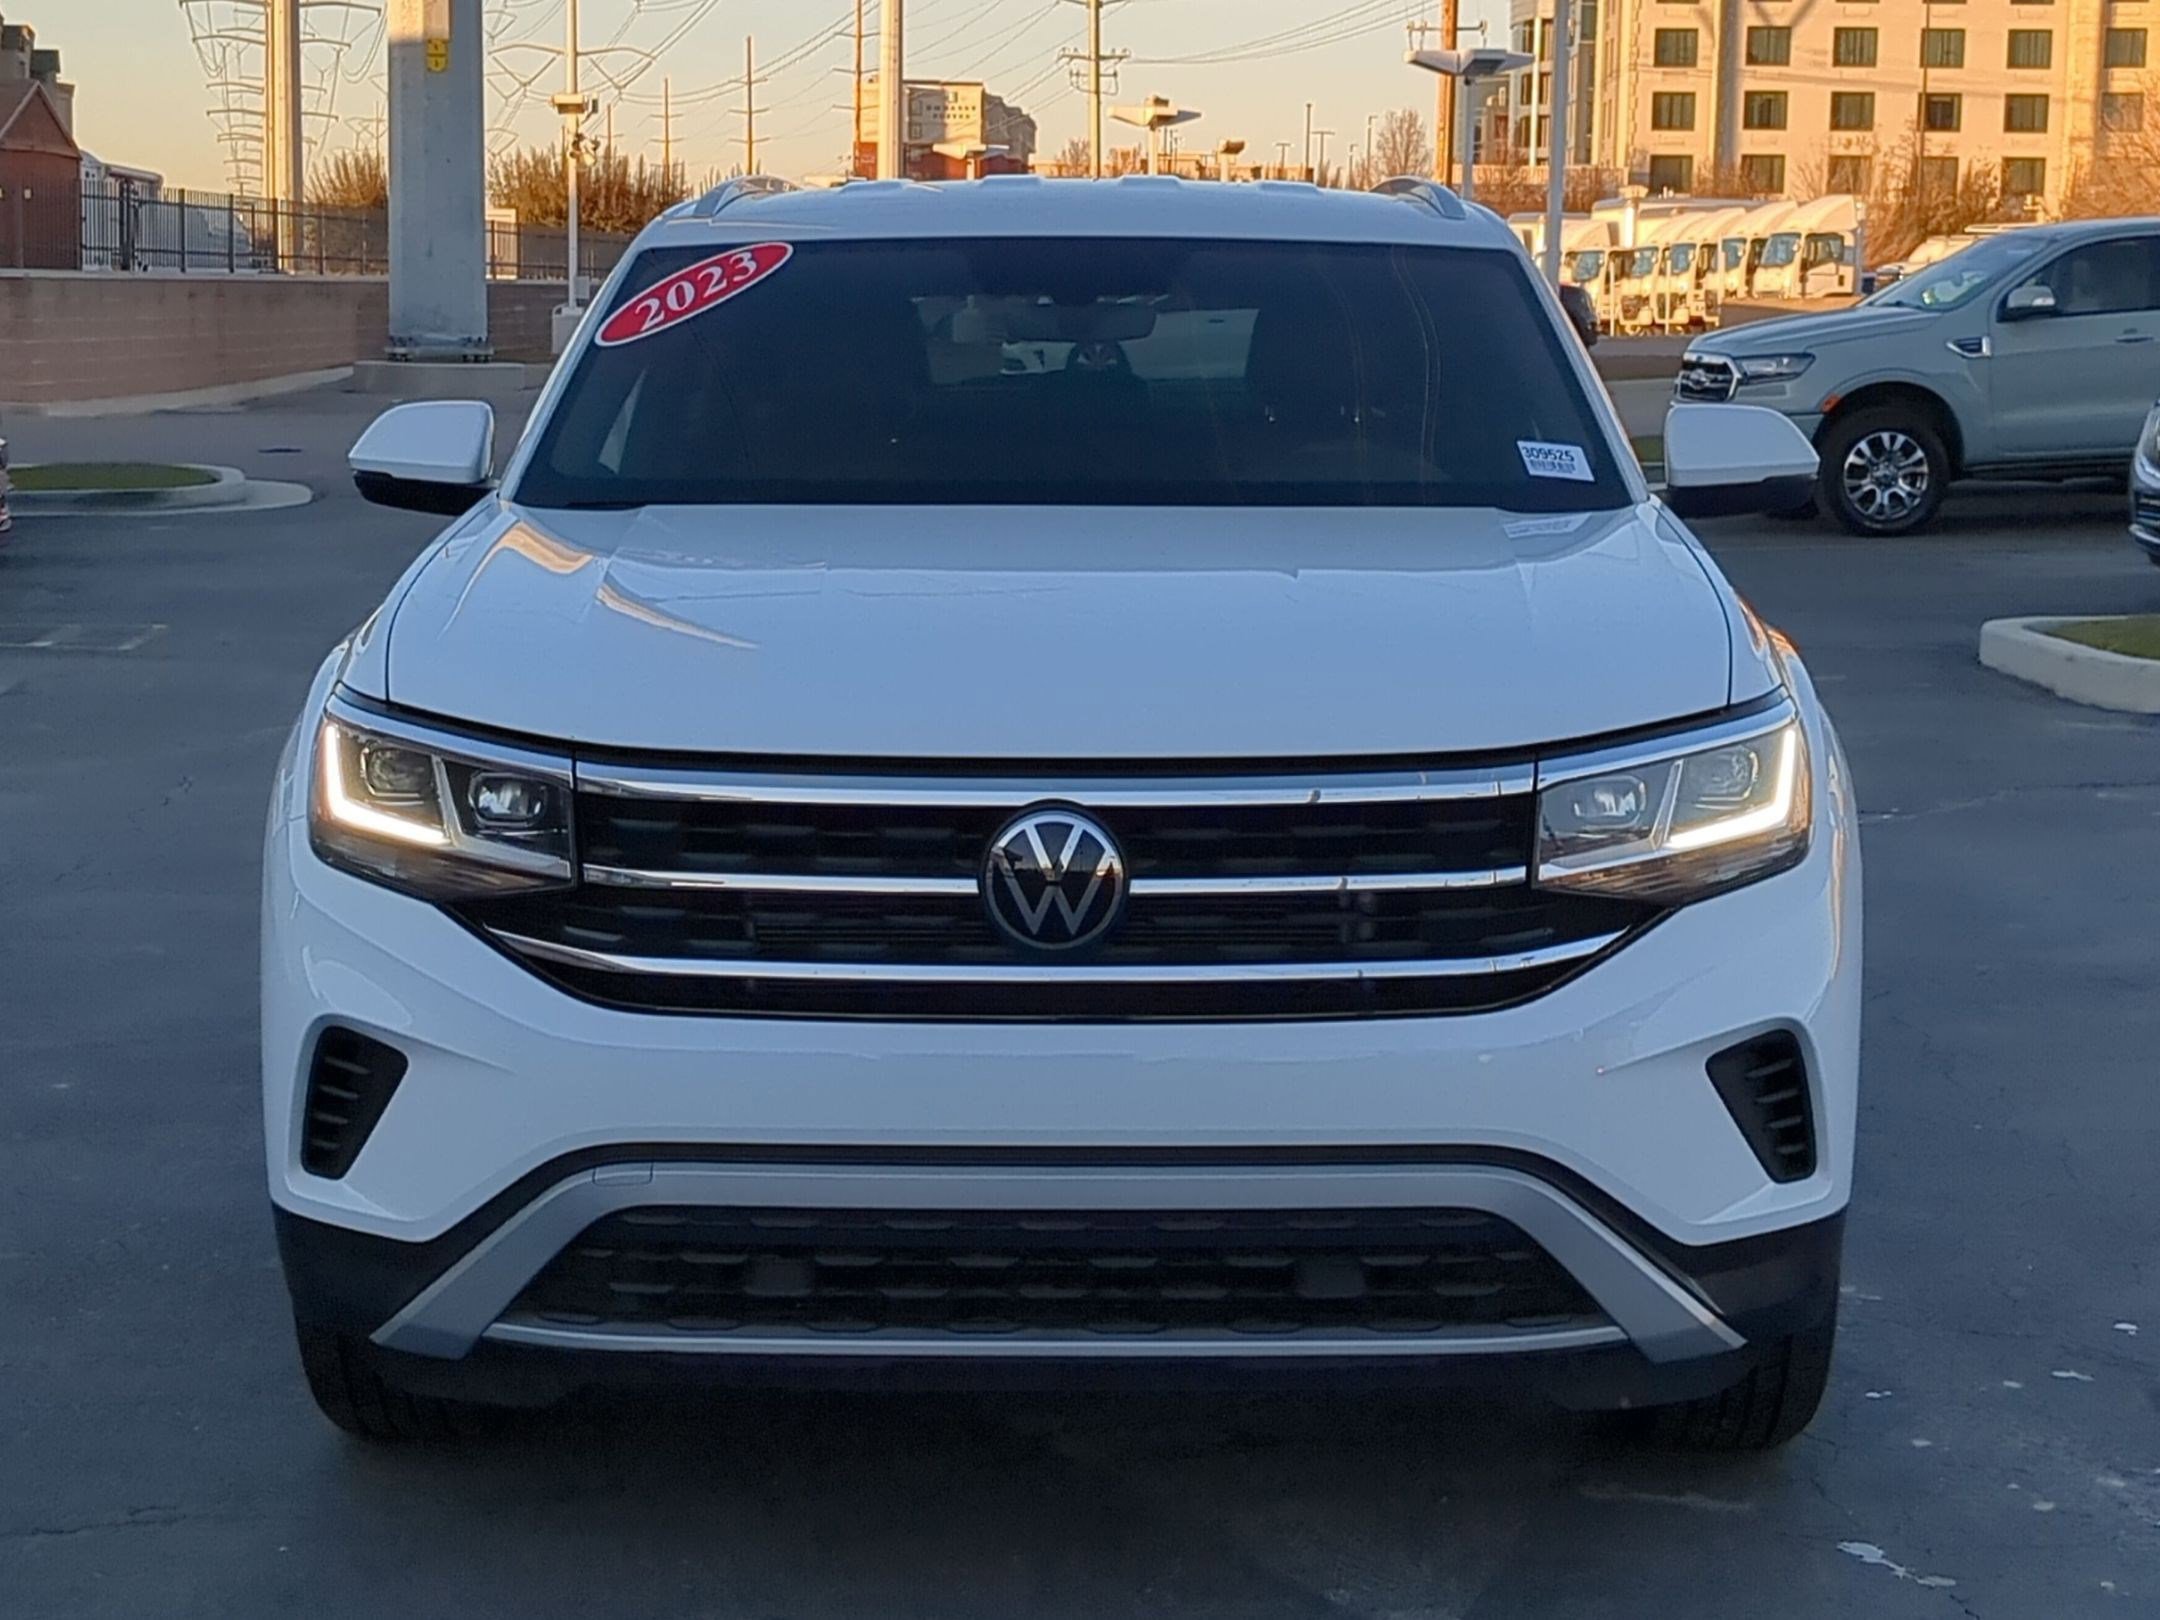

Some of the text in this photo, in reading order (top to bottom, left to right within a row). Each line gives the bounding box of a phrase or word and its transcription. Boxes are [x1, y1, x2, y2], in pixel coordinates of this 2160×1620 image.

[635, 251, 757, 332] 2023
[1522, 446, 1575, 462] 309525
[987, 812, 1122, 942] VW
